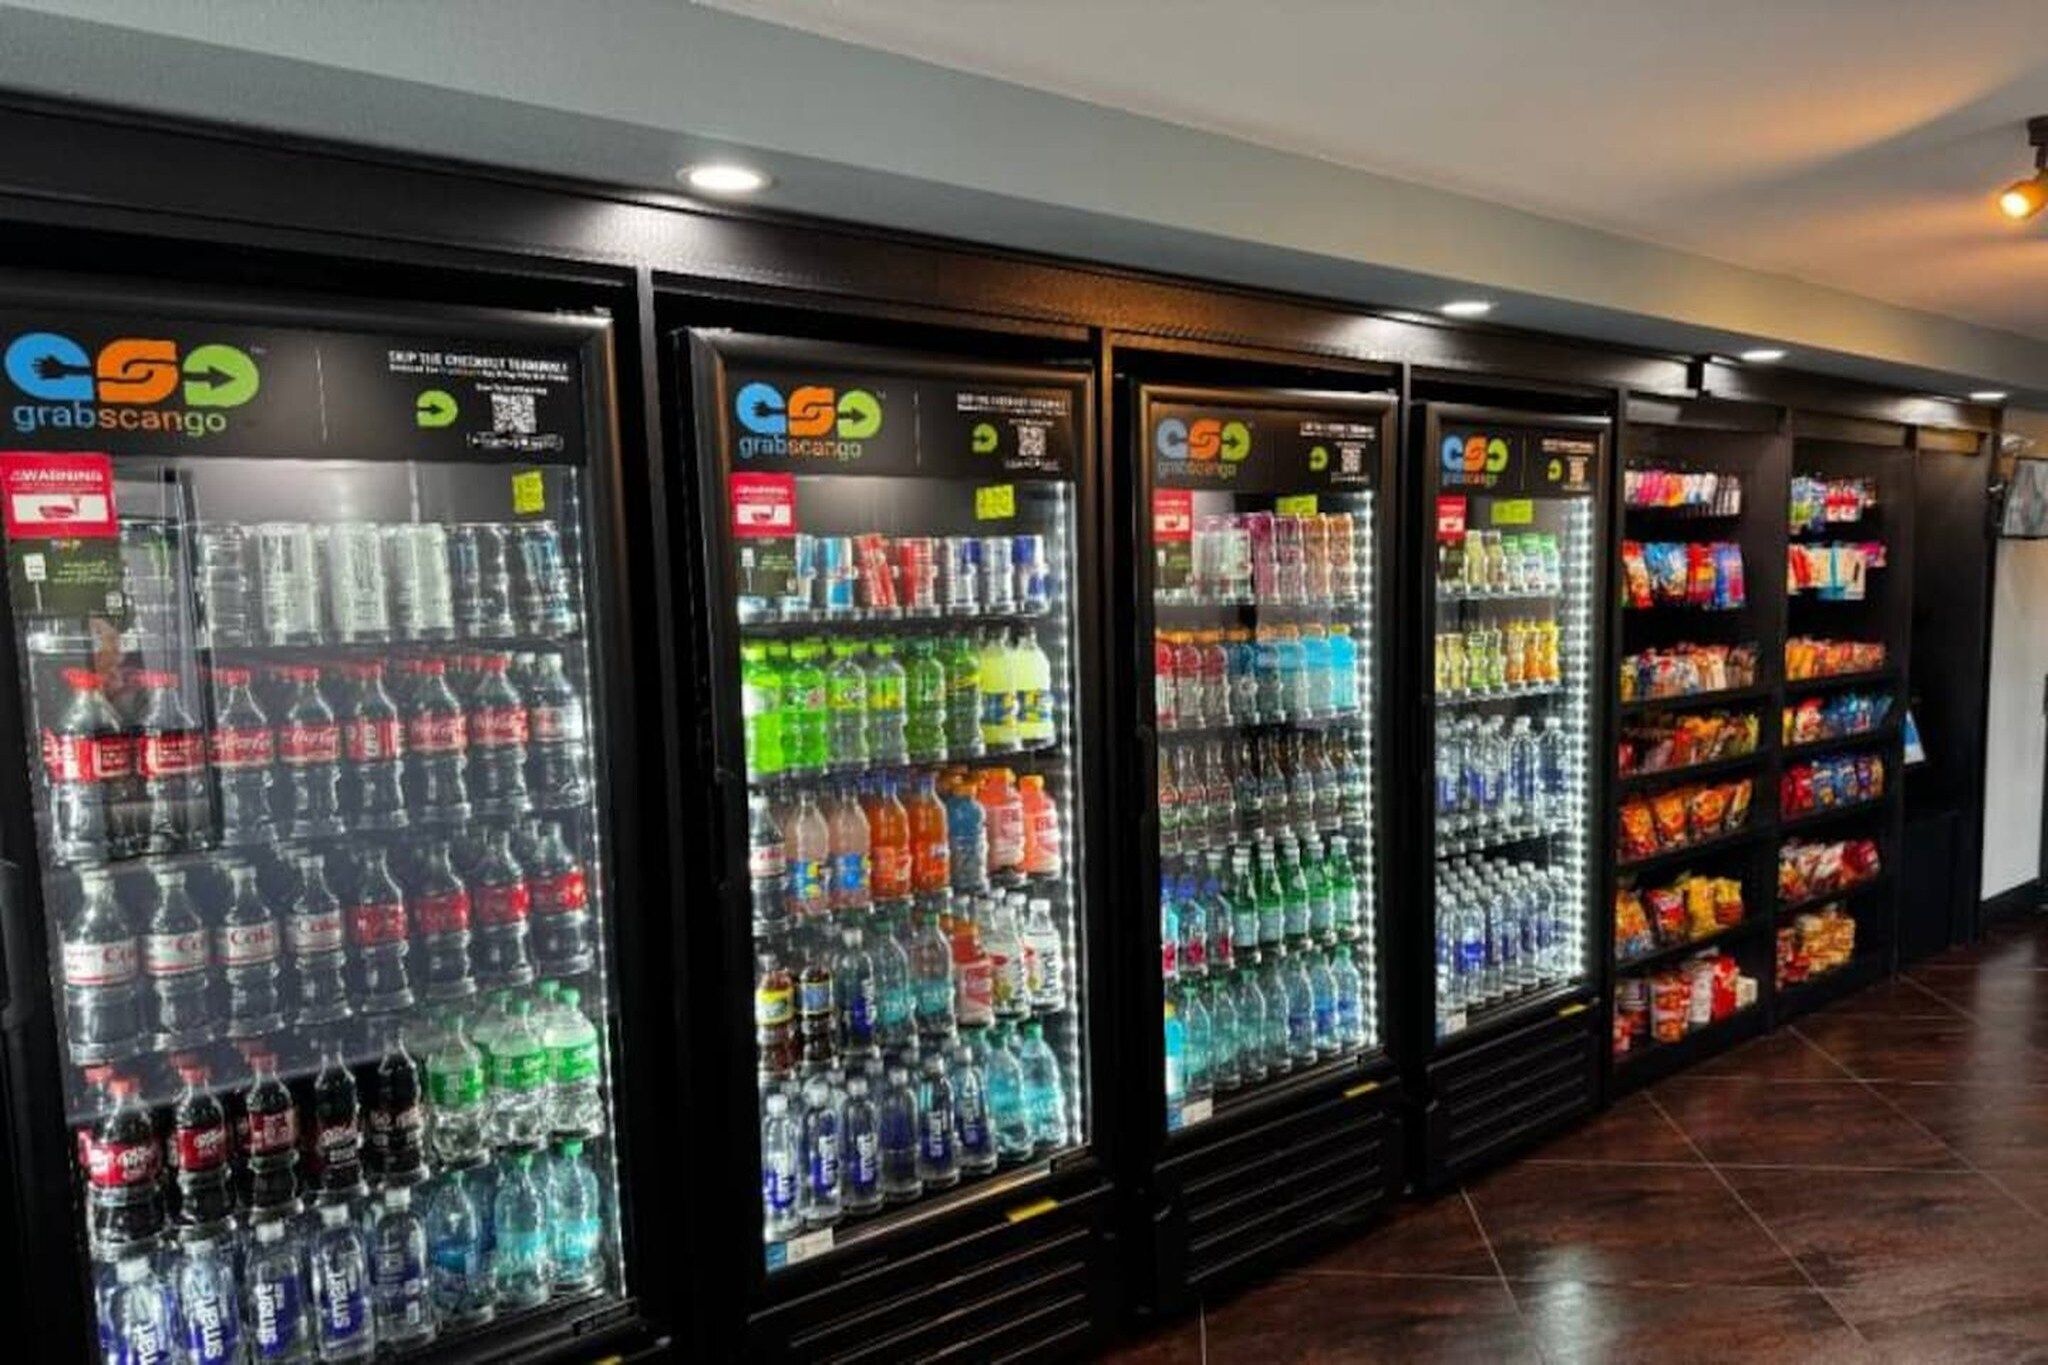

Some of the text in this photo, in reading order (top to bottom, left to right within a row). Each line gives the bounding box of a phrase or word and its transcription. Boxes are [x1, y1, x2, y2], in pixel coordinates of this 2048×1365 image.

[12, 402, 227, 438] grabscango
[739, 435, 862, 461] grabscango
[255, 1283, 277, 1344] smart
[326, 1272, 350, 1328] smart
[134, 1323, 159, 1365] mart
[196, 1298, 223, 1359] smart
